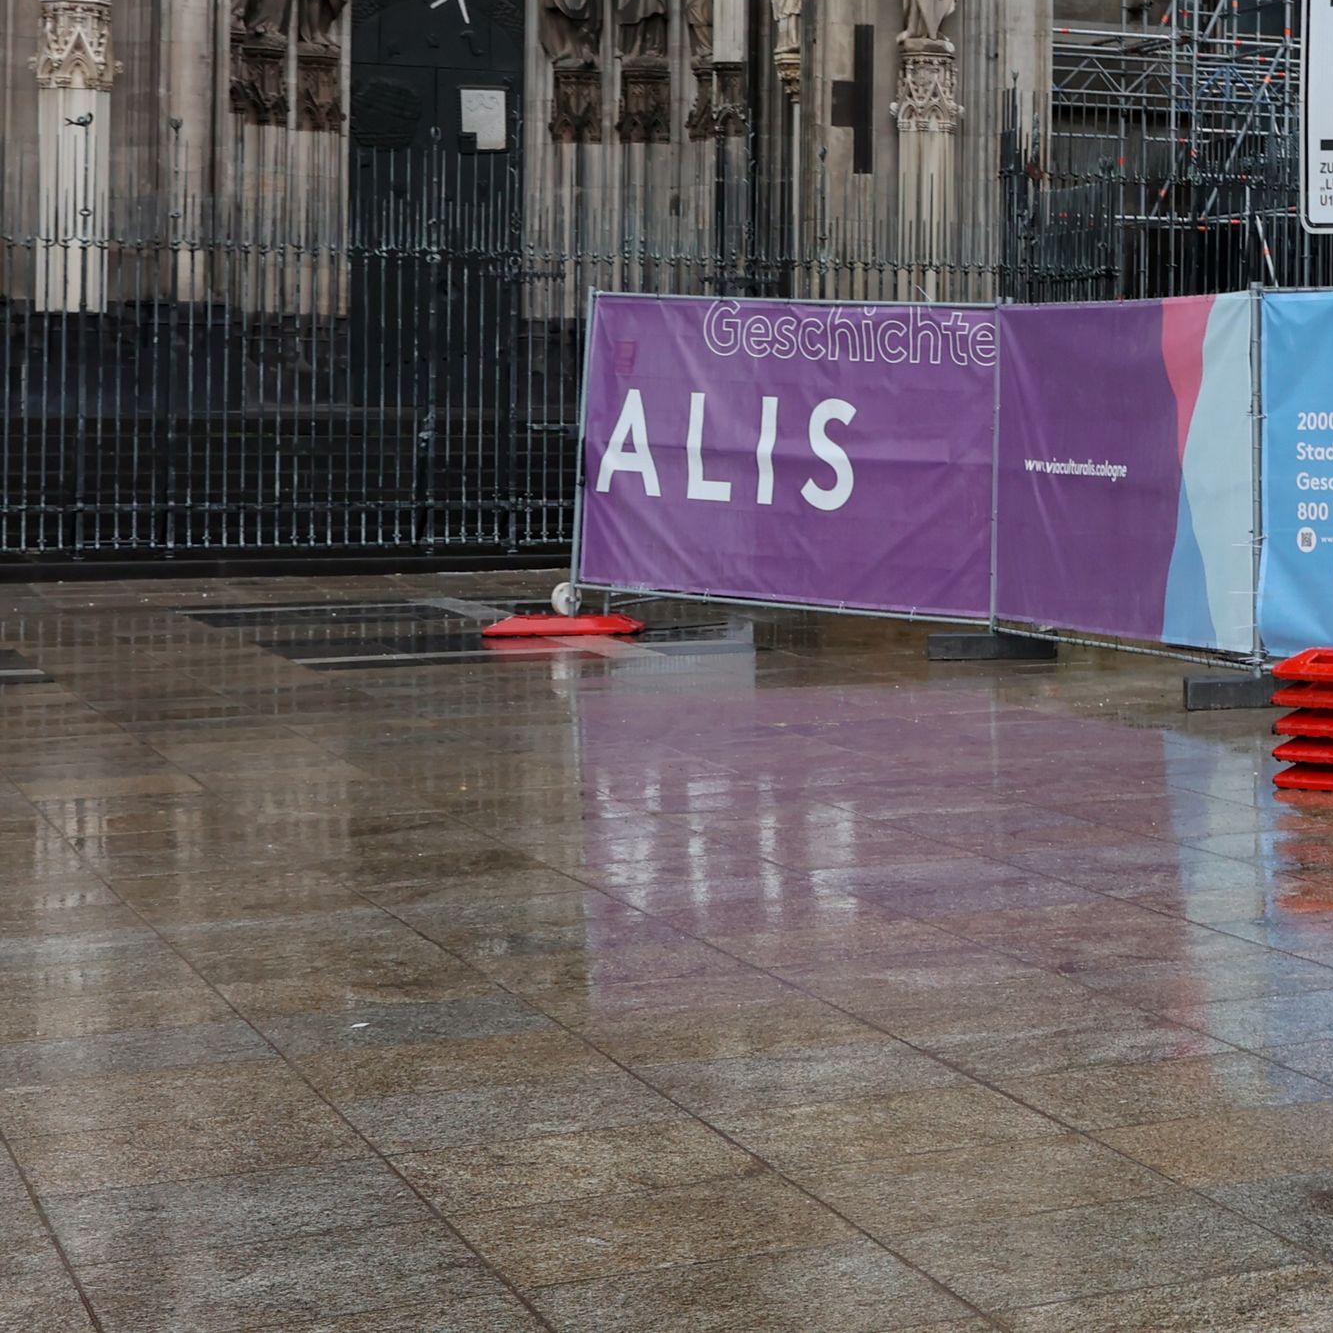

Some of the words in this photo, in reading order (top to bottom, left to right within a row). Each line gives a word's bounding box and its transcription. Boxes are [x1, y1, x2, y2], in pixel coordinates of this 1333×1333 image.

[1320, 195, 1333, 206] U1
[703, 299, 996, 367] Geschichte
[596, 388, 857, 511] ALIS
[1296, 502, 1329, 521] 800
